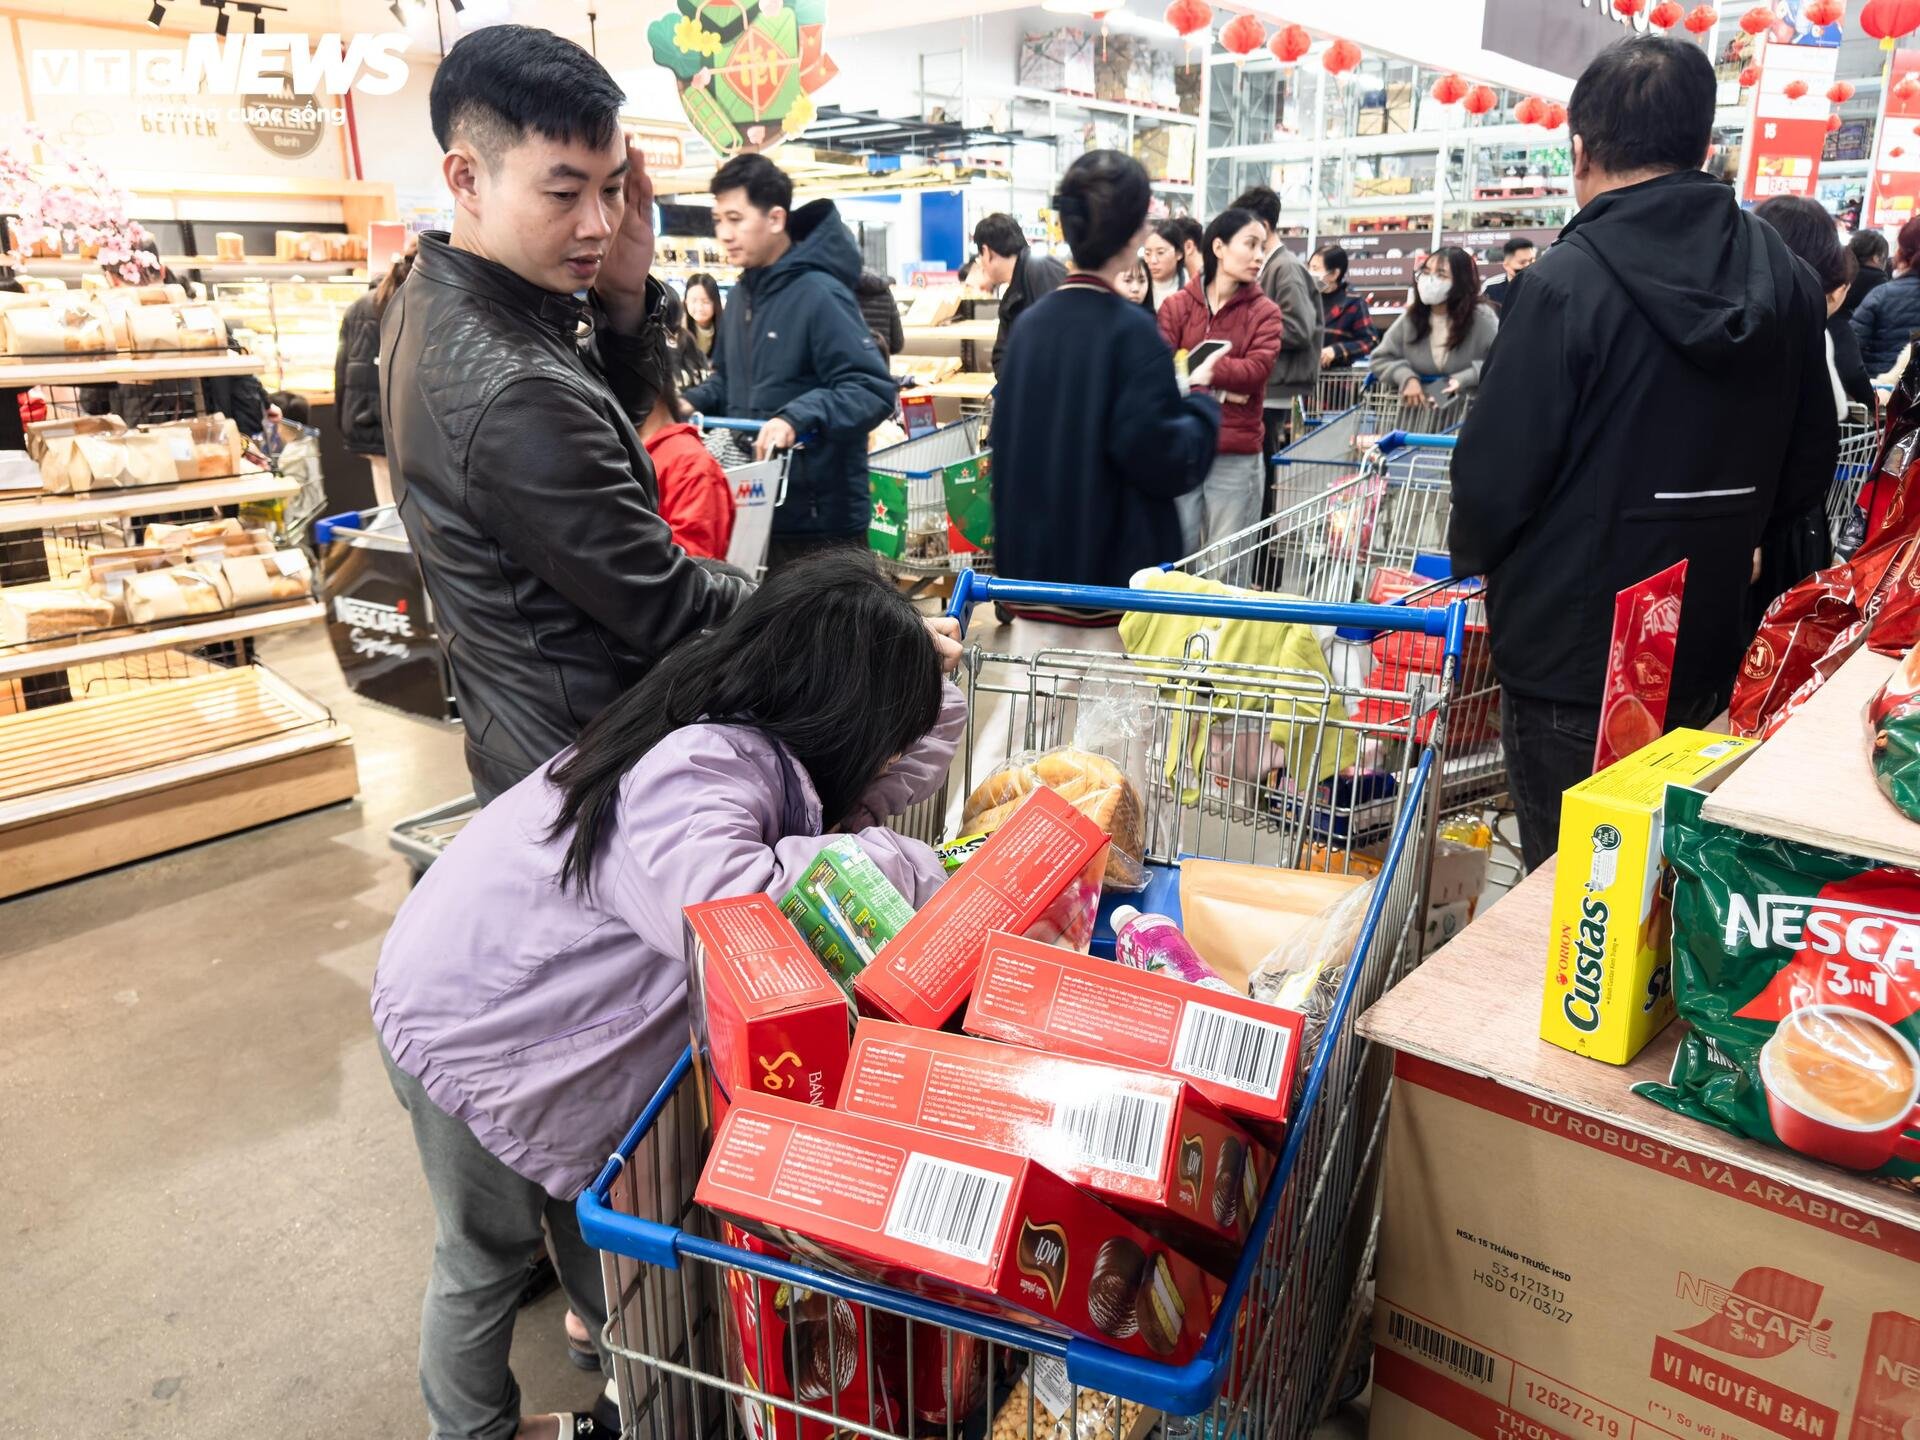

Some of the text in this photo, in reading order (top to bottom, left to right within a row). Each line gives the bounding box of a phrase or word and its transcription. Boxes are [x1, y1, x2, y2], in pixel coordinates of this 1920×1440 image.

[1559, 924, 1571, 970] ORION
[1564, 896, 1610, 1034] Custas
[1190, 1067, 1219, 1081] 935132
[1236, 1081, 1265, 1095] 515080
[1114, 1162, 1146, 1176] 515080
[1527, 1101, 1882, 1239] TỪ ROBUSTA VÀ ARABICA
[1456, 1228, 1477, 1243] NSX:
[1478, 1237, 1489, 1248] 15
[1552, 1268, 1571, 1282] HSD
[1473, 1268, 1573, 1324] HSD 07/03/27
[1525, 1381, 1619, 1438] 12627219
[1663, 1352, 1682, 1380] VỊ
[1688, 1366, 1773, 1416] NGUYÊN
[1779, 1403, 1825, 1437] BẢN
[1676, 1412, 1692, 1428] So
[1696, 1423, 1716, 1438] với
